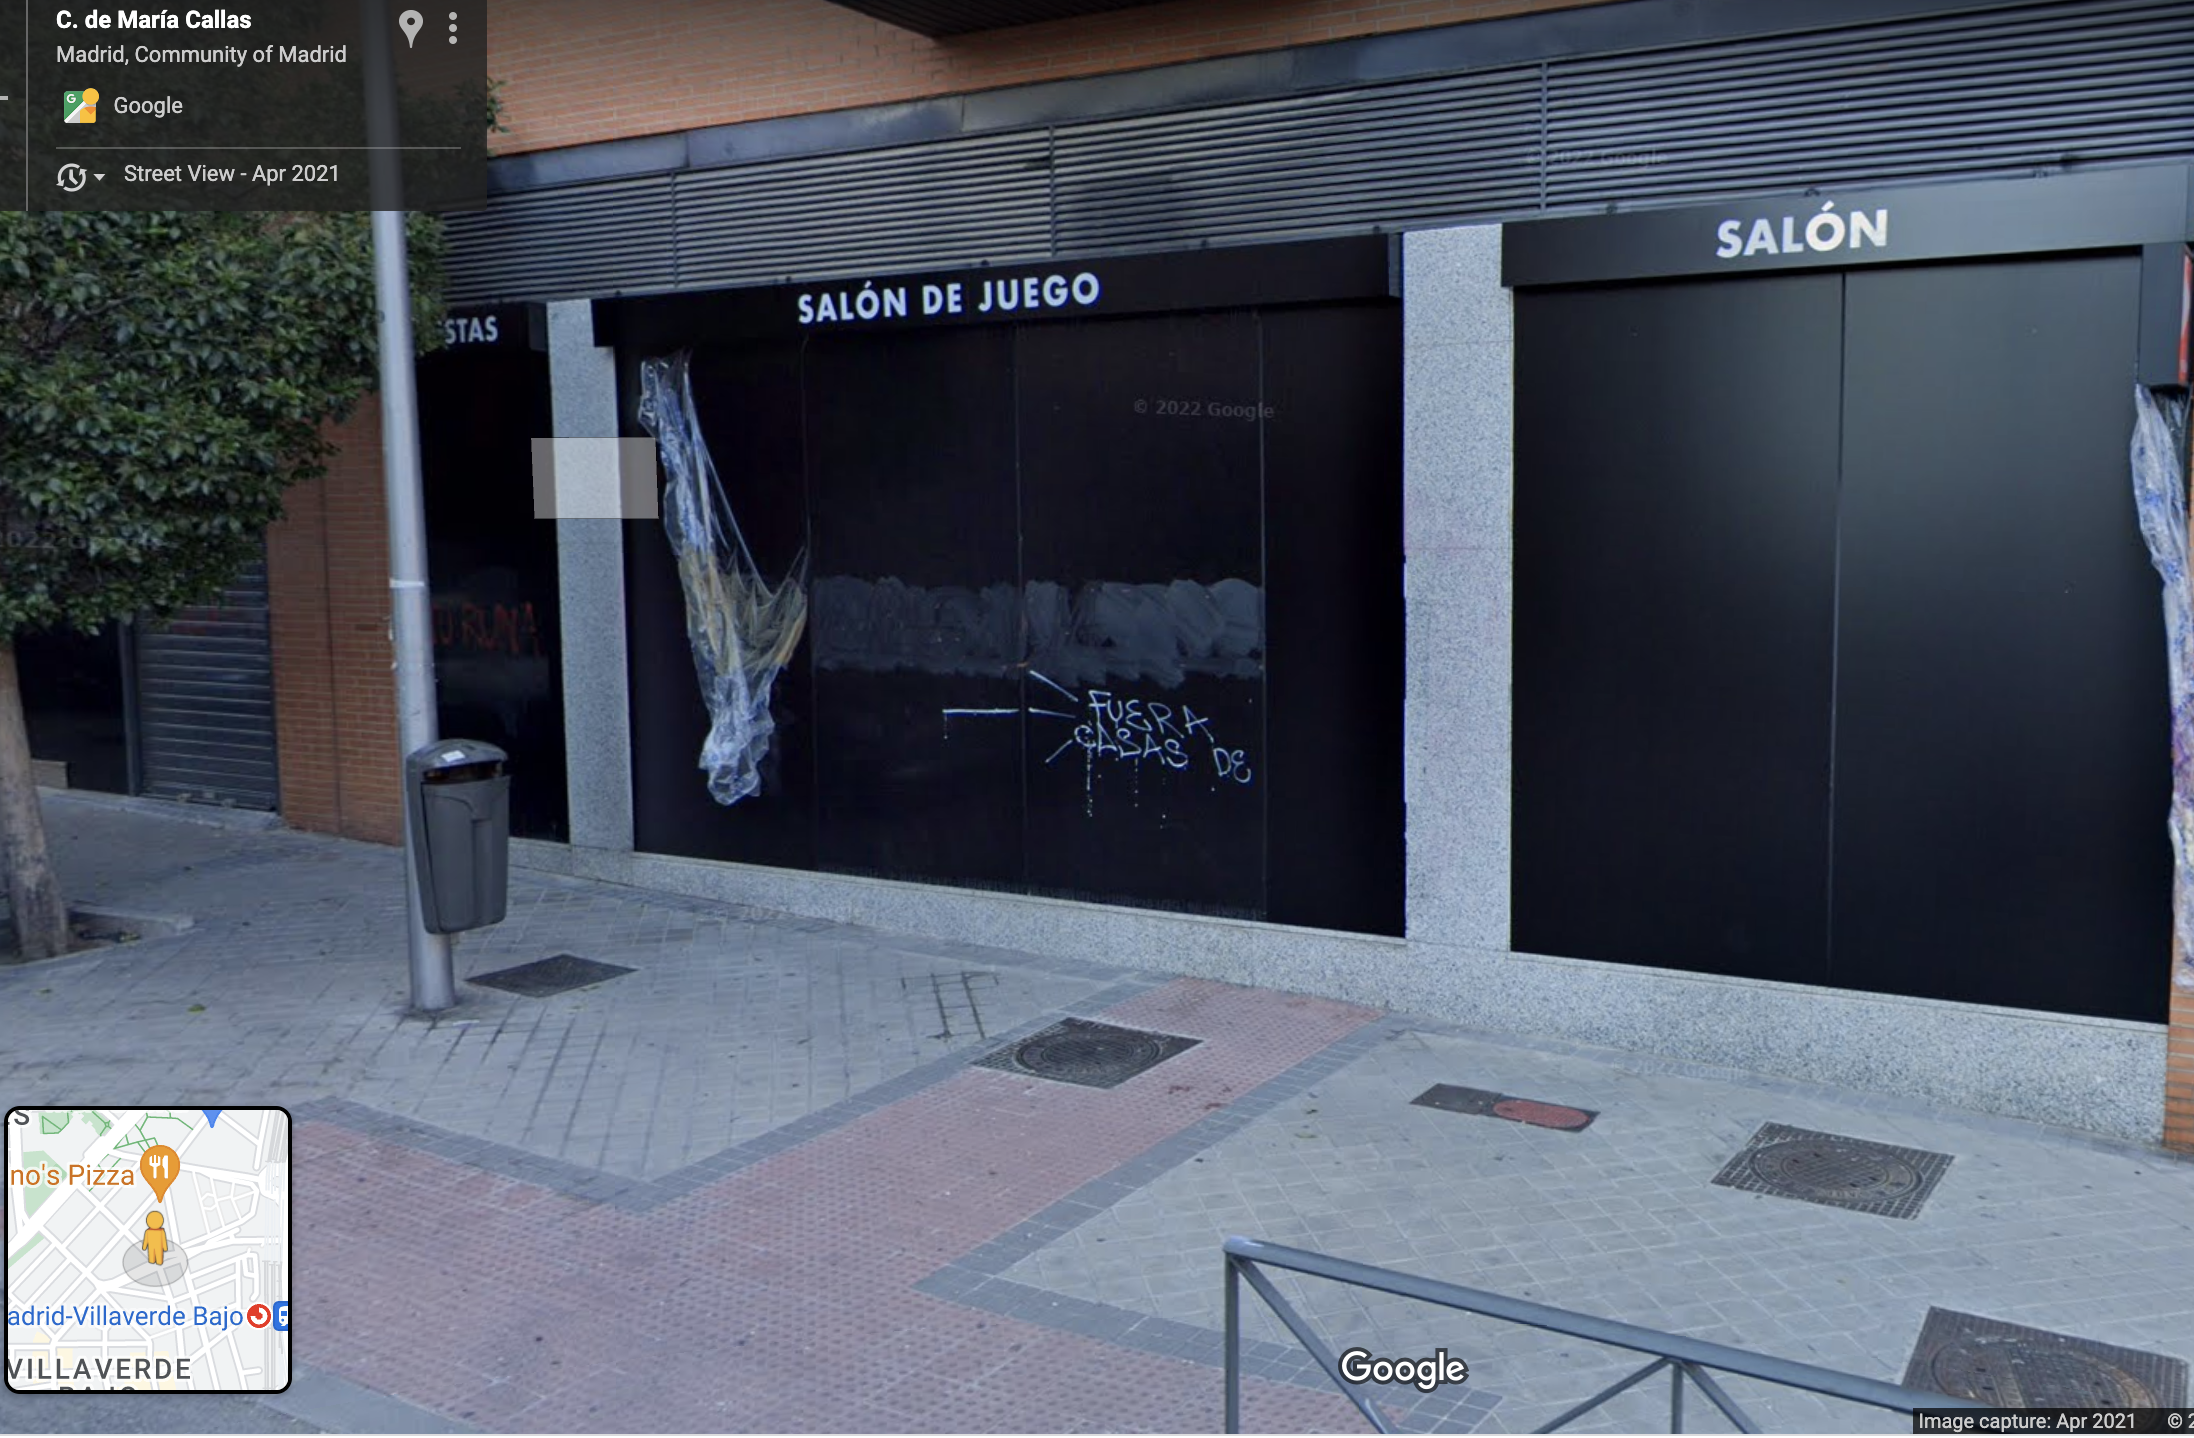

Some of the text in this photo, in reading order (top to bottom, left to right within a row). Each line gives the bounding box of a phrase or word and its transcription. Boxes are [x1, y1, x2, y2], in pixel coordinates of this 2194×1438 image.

[1716, 201, 1888, 258] SALÓN
[798, 272, 1100, 324] SALÓN DE JUEGO
[440, 315, 499, 344] STAS
[1088, 689, 1214, 743] FUERA
[1073, 722, 1252, 784] CASAS DE
